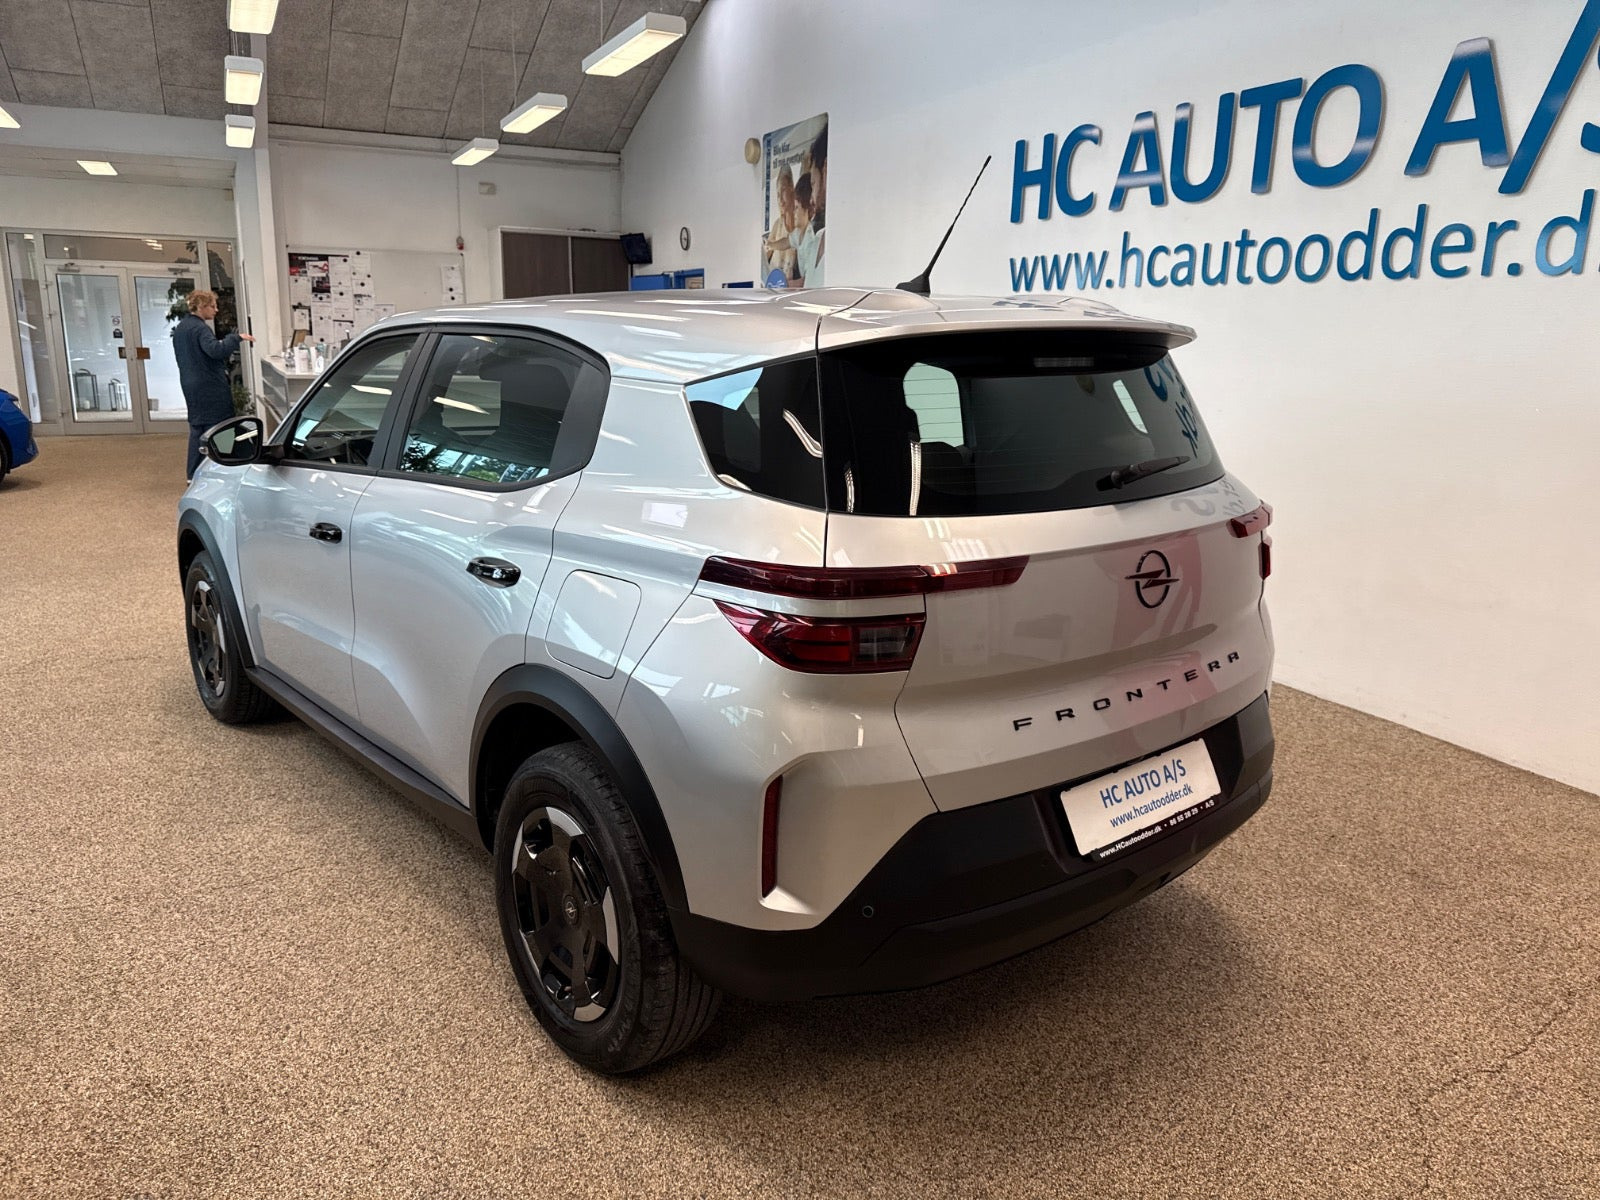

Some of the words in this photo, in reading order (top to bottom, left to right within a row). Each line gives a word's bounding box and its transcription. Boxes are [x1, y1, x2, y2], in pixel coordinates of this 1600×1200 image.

[1010, 124, 1102, 224] HC
[1108, 63, 1386, 212] AUTO
[1403, 0, 1600, 196] A/
[1009, 188, 1600, 293] www.hcautoodder.d
[1099, 785, 1122, 809] HC
[1124, 769, 1161, 800] AUTO
[1163, 759, 1186, 783] A/S
[1109, 783, 1193, 828] www.hcautoodder.dk
